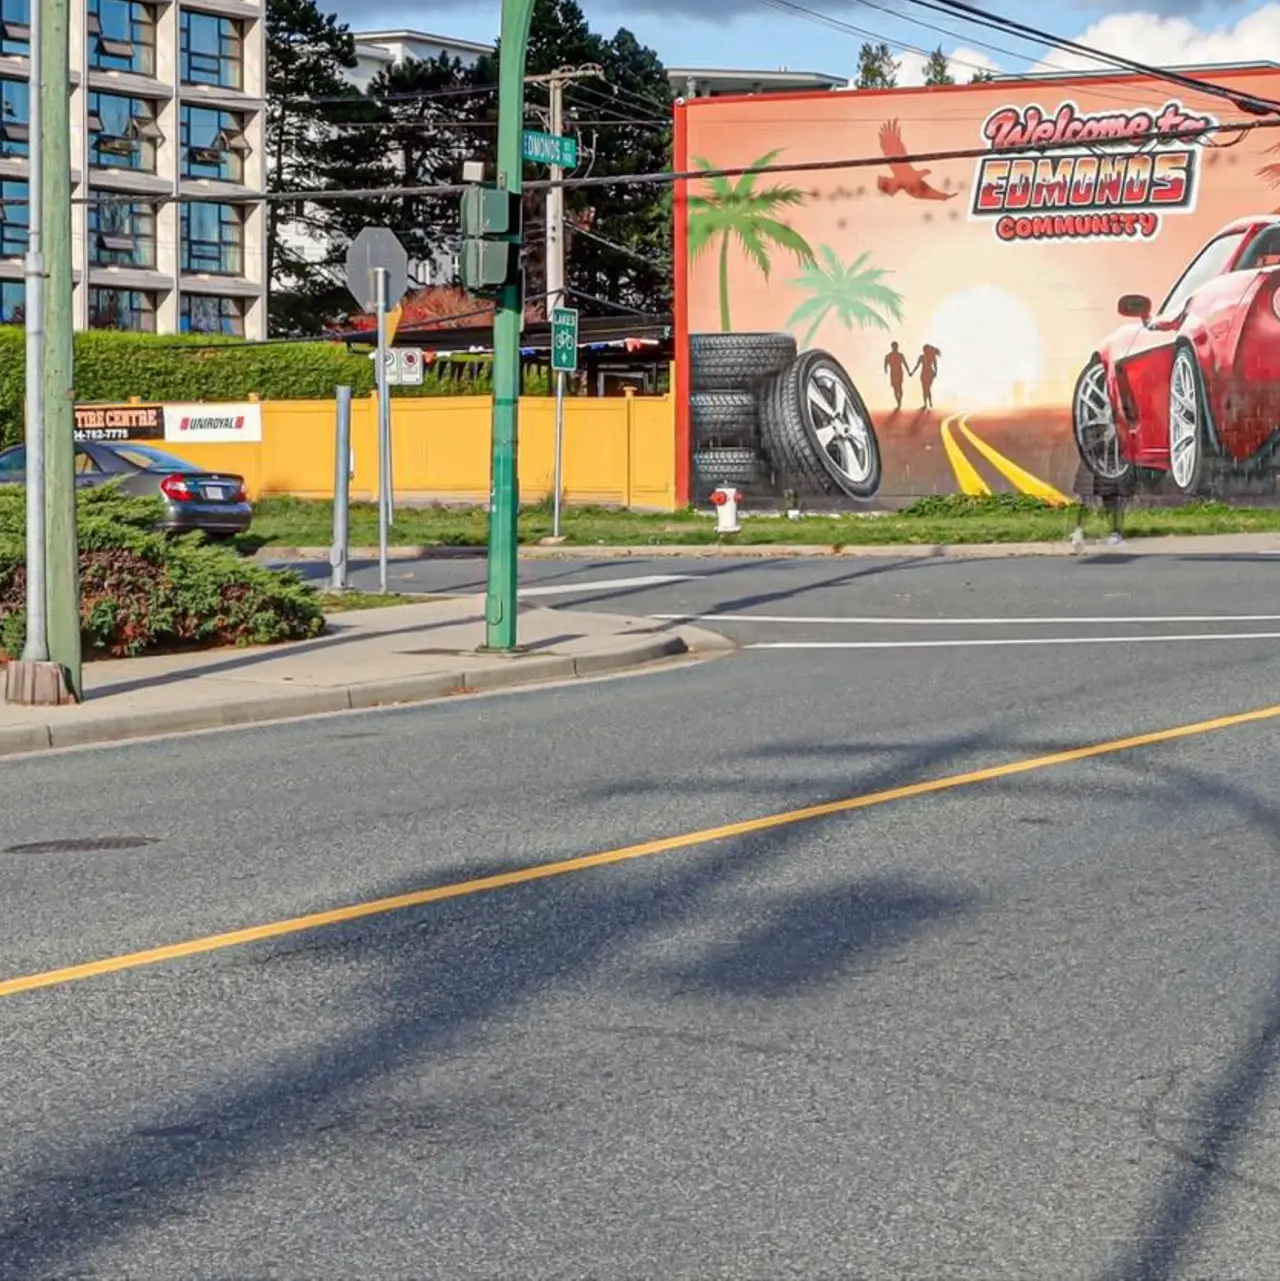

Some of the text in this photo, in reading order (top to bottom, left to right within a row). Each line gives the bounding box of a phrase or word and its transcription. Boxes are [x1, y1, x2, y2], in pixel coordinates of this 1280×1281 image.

[984, 103, 1210, 151] Welcome to
[523, 133, 561, 160] EDMONDS
[977, 152, 1190, 210] EDMONDS
[996, 213, 1158, 240] COMMUNITY
[75, 410, 157, 427] TIRE CENTRE
[190, 417, 234, 430] UNIROYAL
